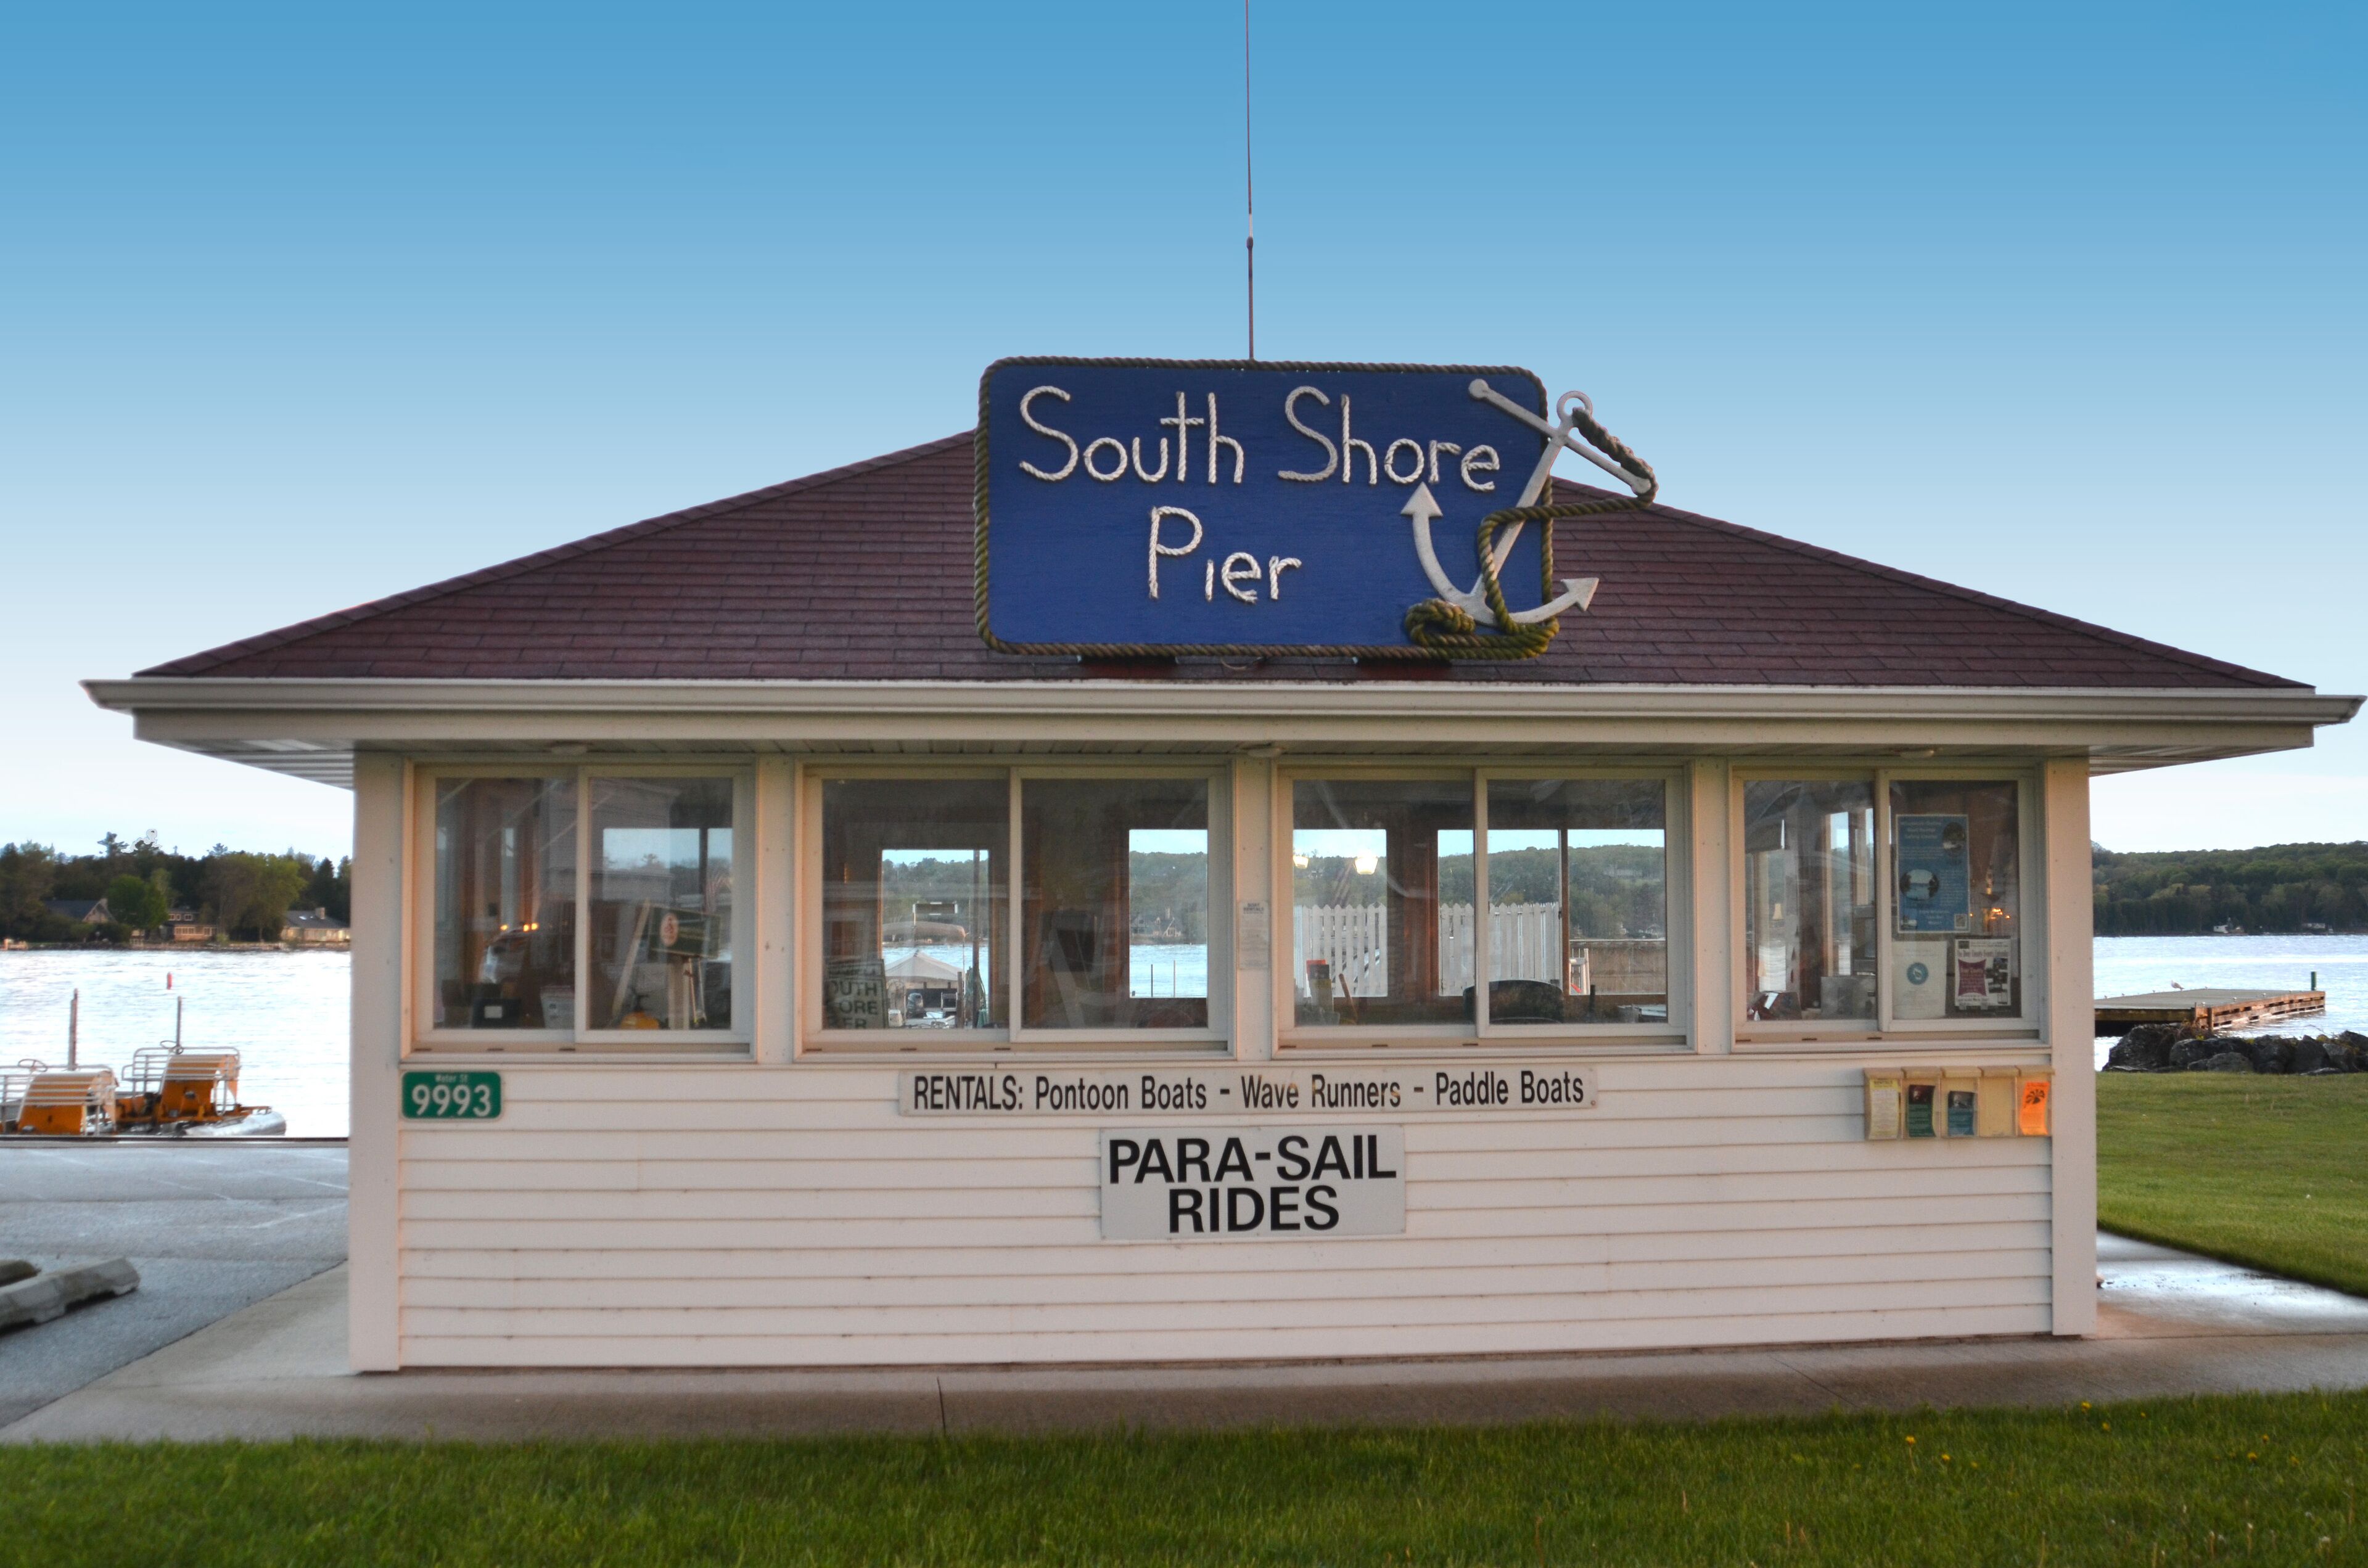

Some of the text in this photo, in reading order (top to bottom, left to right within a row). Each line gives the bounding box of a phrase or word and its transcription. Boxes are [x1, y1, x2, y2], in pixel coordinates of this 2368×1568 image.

[1021, 385, 1500, 491] South Shore
[1148, 506, 1302, 604] Pier
[826, 980, 878, 997] OUTH
[839, 1000, 879, 1016] ORE
[412, 1084, 491, 1117] 9993
[914, 1075, 1023, 1110] RENTALS:
[1036, 1076, 1128, 1110] Pontoon
[1141, 1075, 1207, 1110] Boats
[1240, 1075, 1299, 1109] Wave
[1312, 1074, 1401, 1108] Runners
[1436, 1071, 1509, 1106] Paddle
[1521, 1070, 1584, 1104] Boats
[1109, 1135, 1397, 1184] PARA-SAIL
[1169, 1184, 1339, 1233] RIDES
